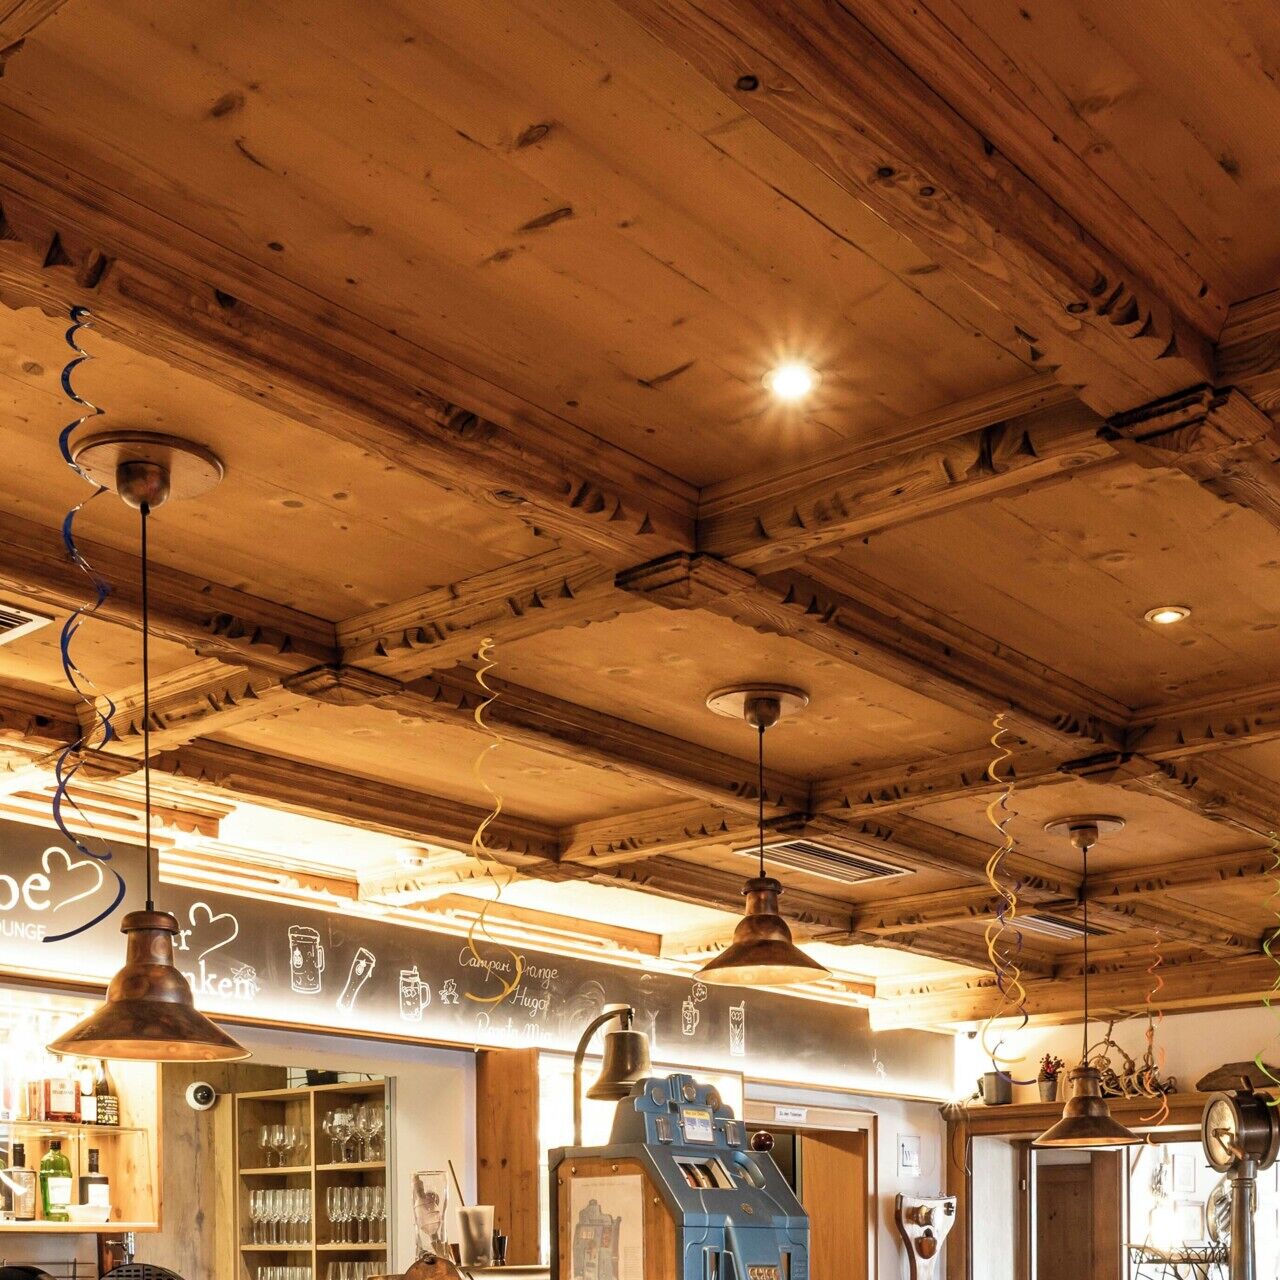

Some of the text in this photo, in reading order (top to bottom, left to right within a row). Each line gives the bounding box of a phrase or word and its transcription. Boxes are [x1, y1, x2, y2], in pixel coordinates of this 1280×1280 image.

[458, 946, 560, 989] Campari Orange
[510, 984, 549, 1018] Hugo
